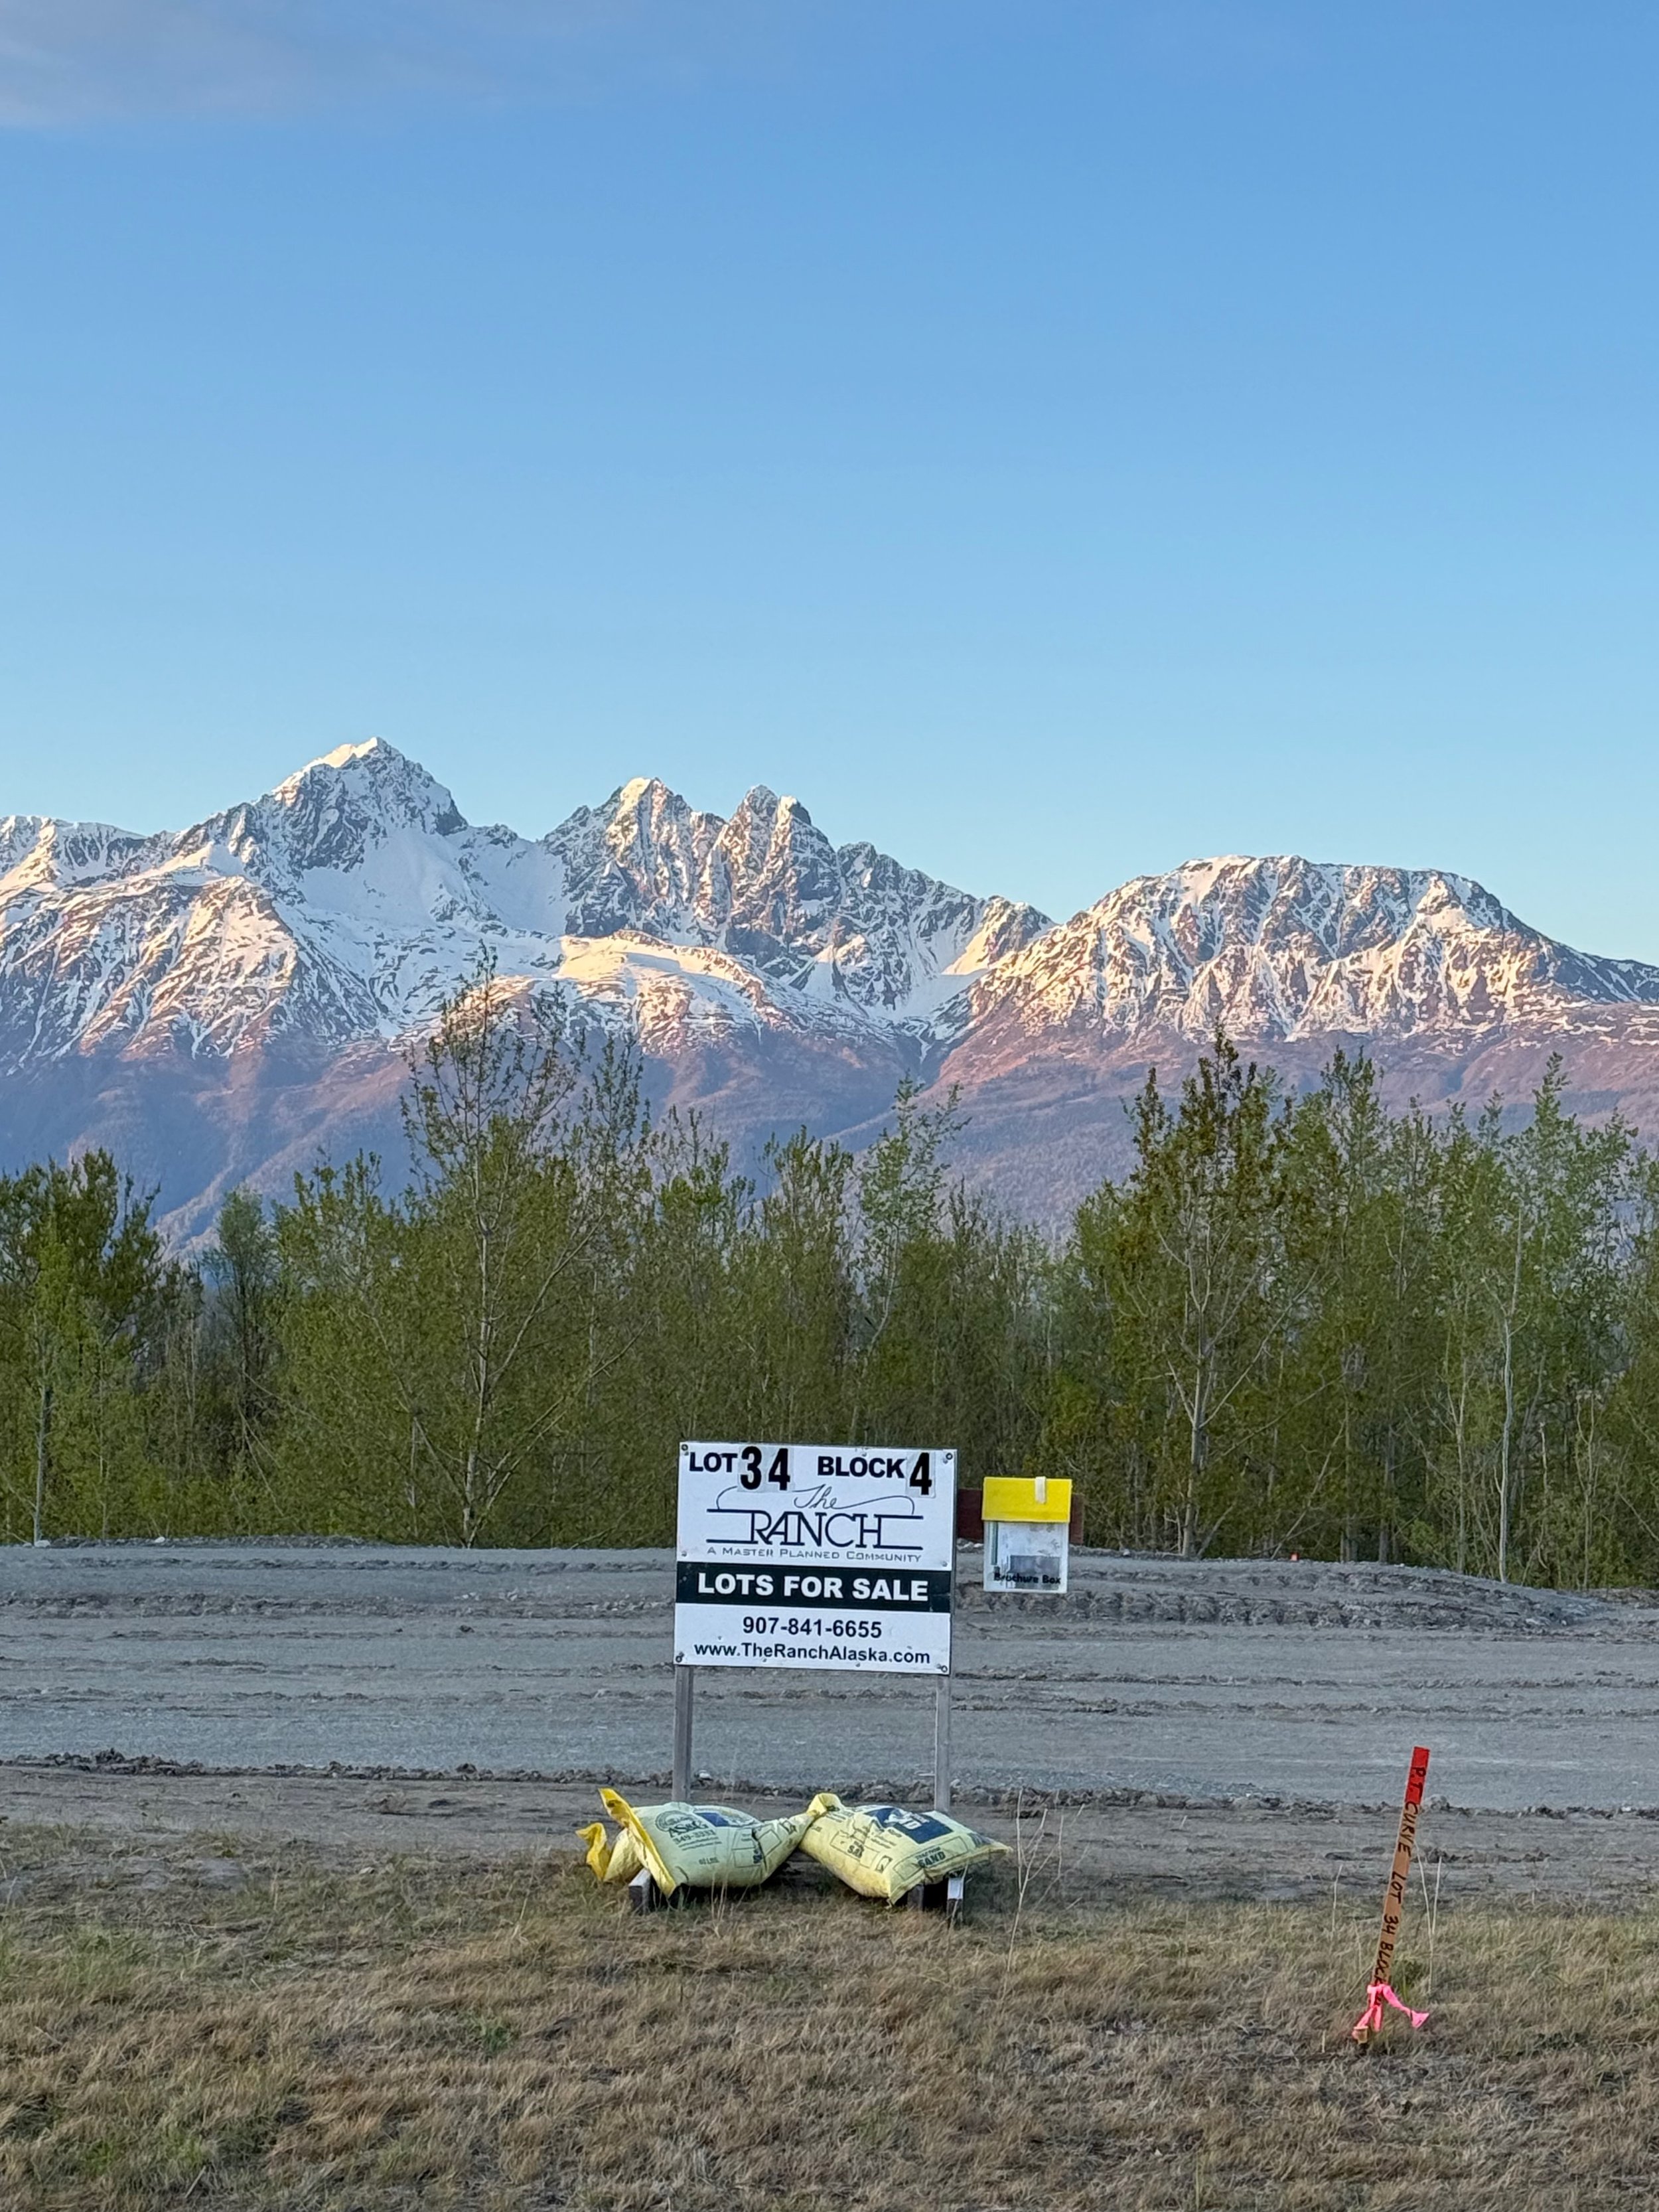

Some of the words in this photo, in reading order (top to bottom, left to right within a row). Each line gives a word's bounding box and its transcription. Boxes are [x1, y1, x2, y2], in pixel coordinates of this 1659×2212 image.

[689, 1452, 737, 1473] LOT
[740, 1446, 790, 1491] 34
[817, 1455, 906, 1479] BLOCK
[909, 1452, 932, 1496] 4
[794, 1483, 837, 1509] The
[751, 1510, 882, 1549] RANCH
[707, 1546, 717, 1556] A
[780, 1548, 840, 1560] PLANNED
[697, 1572, 774, 1596] LOTS
[783, 1576, 843, 1599] FOR
[852, 1578, 929, 1602] SALE
[1042, 1574, 1061, 1585] Box
[742, 1616, 883, 1639] 907-841-6655
[694, 1642, 930, 1664] www.TheRanchAlaska.com
[1398, 1801, 1419, 1858] CURVE
[917, 1850, 946, 1868] SAND
[1390, 1871, 1407, 1904] LOT
[1382, 1913, 1399, 1935] 34
